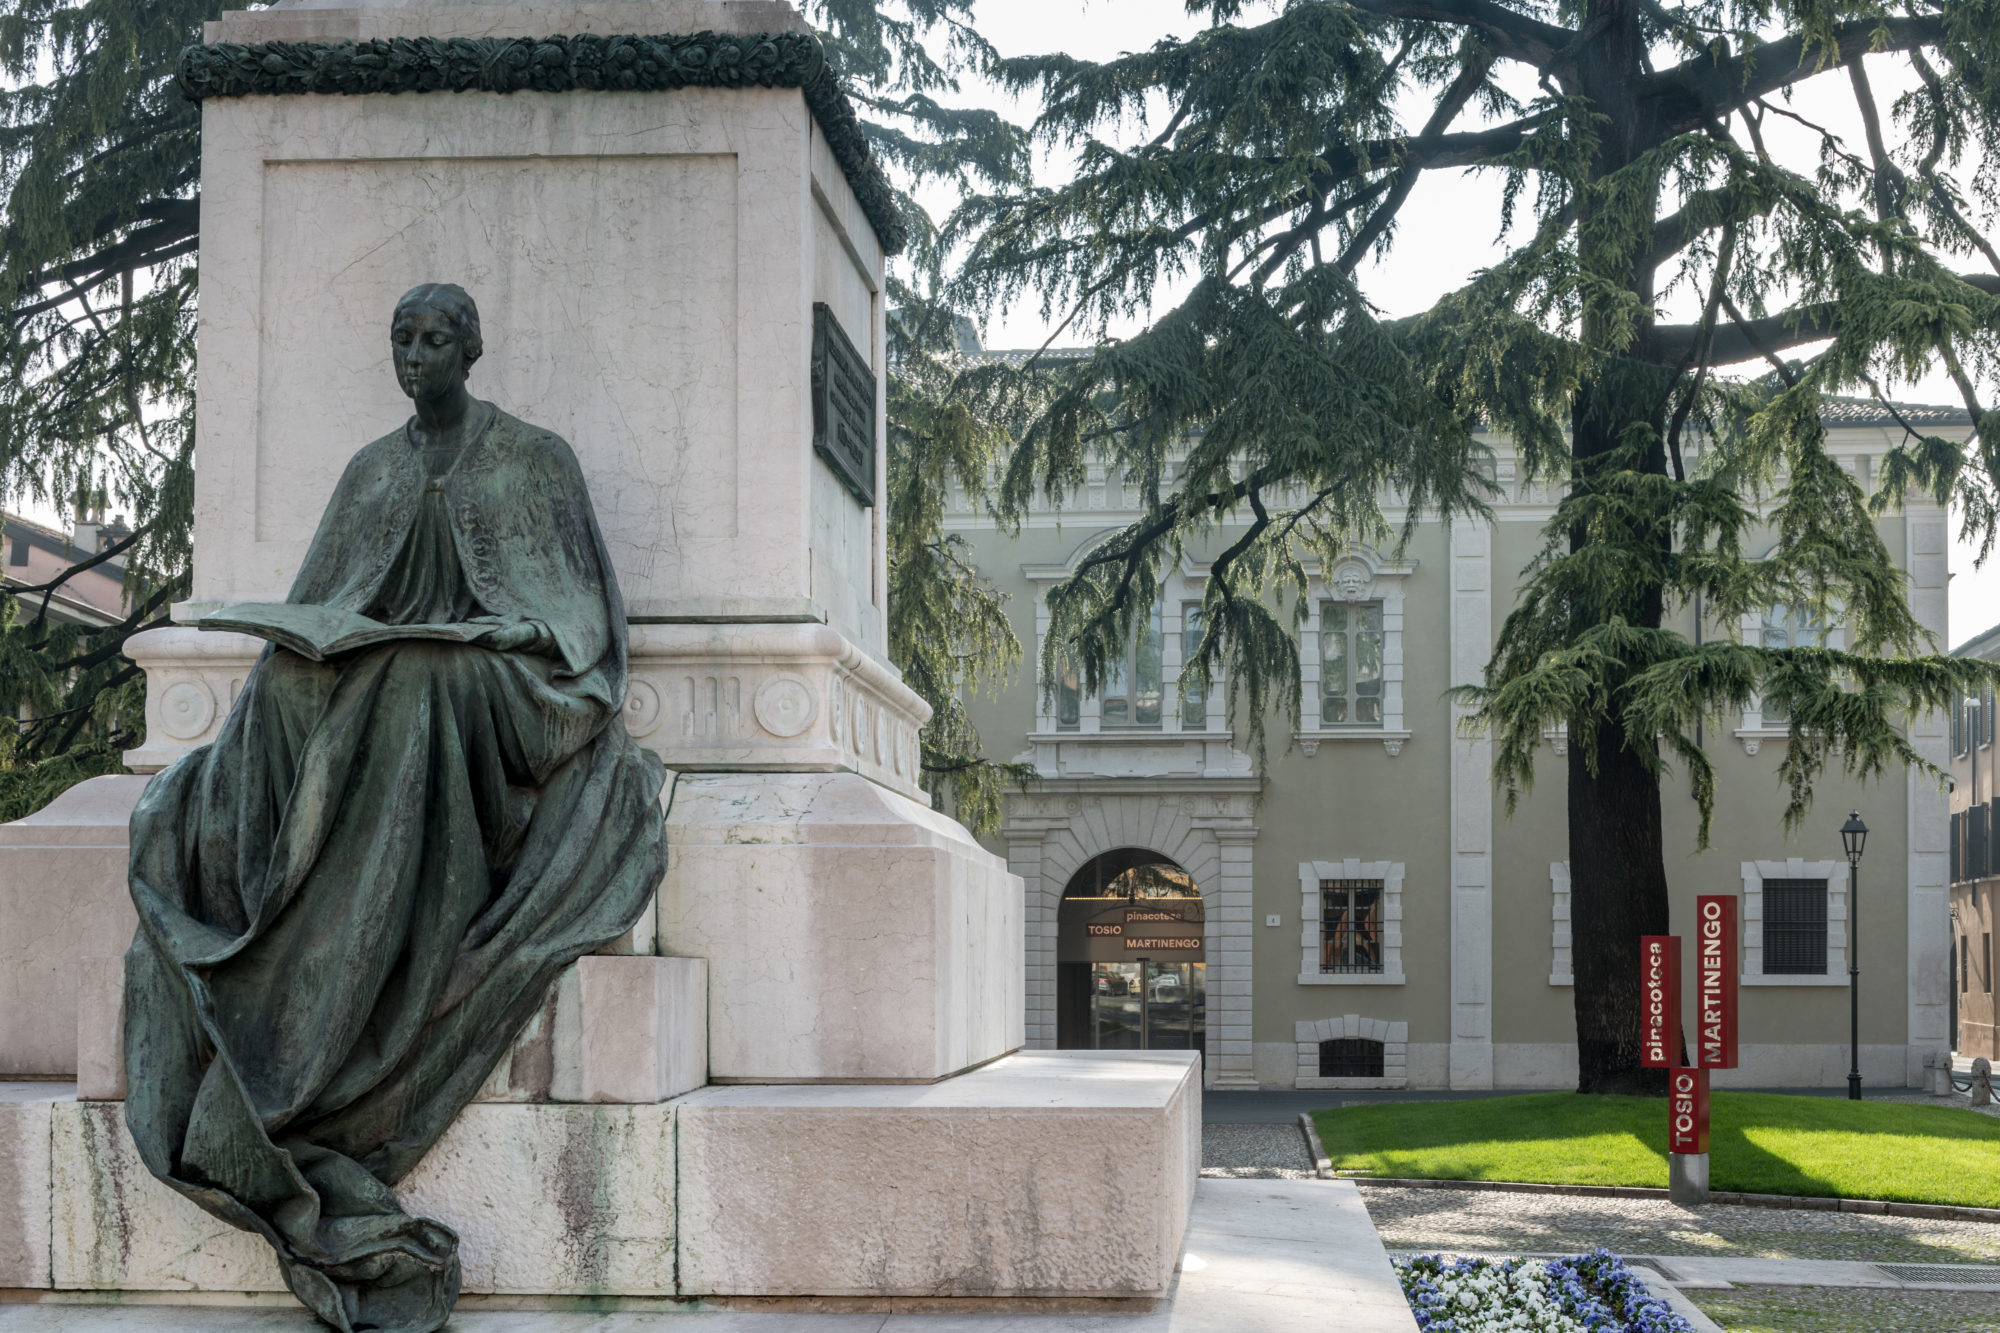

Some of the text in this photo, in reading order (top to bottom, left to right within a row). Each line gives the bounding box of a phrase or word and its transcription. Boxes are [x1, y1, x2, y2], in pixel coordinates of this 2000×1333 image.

[1088, 925, 1122, 935] TOSIO
[1126, 939, 1200, 948] MARTINENGO
[1646, 942, 1666, 1061] pinacoteca
[1703, 902, 1721, 1063] MARTINENGO
[1675, 1074, 1693, 1147] TOSIO
